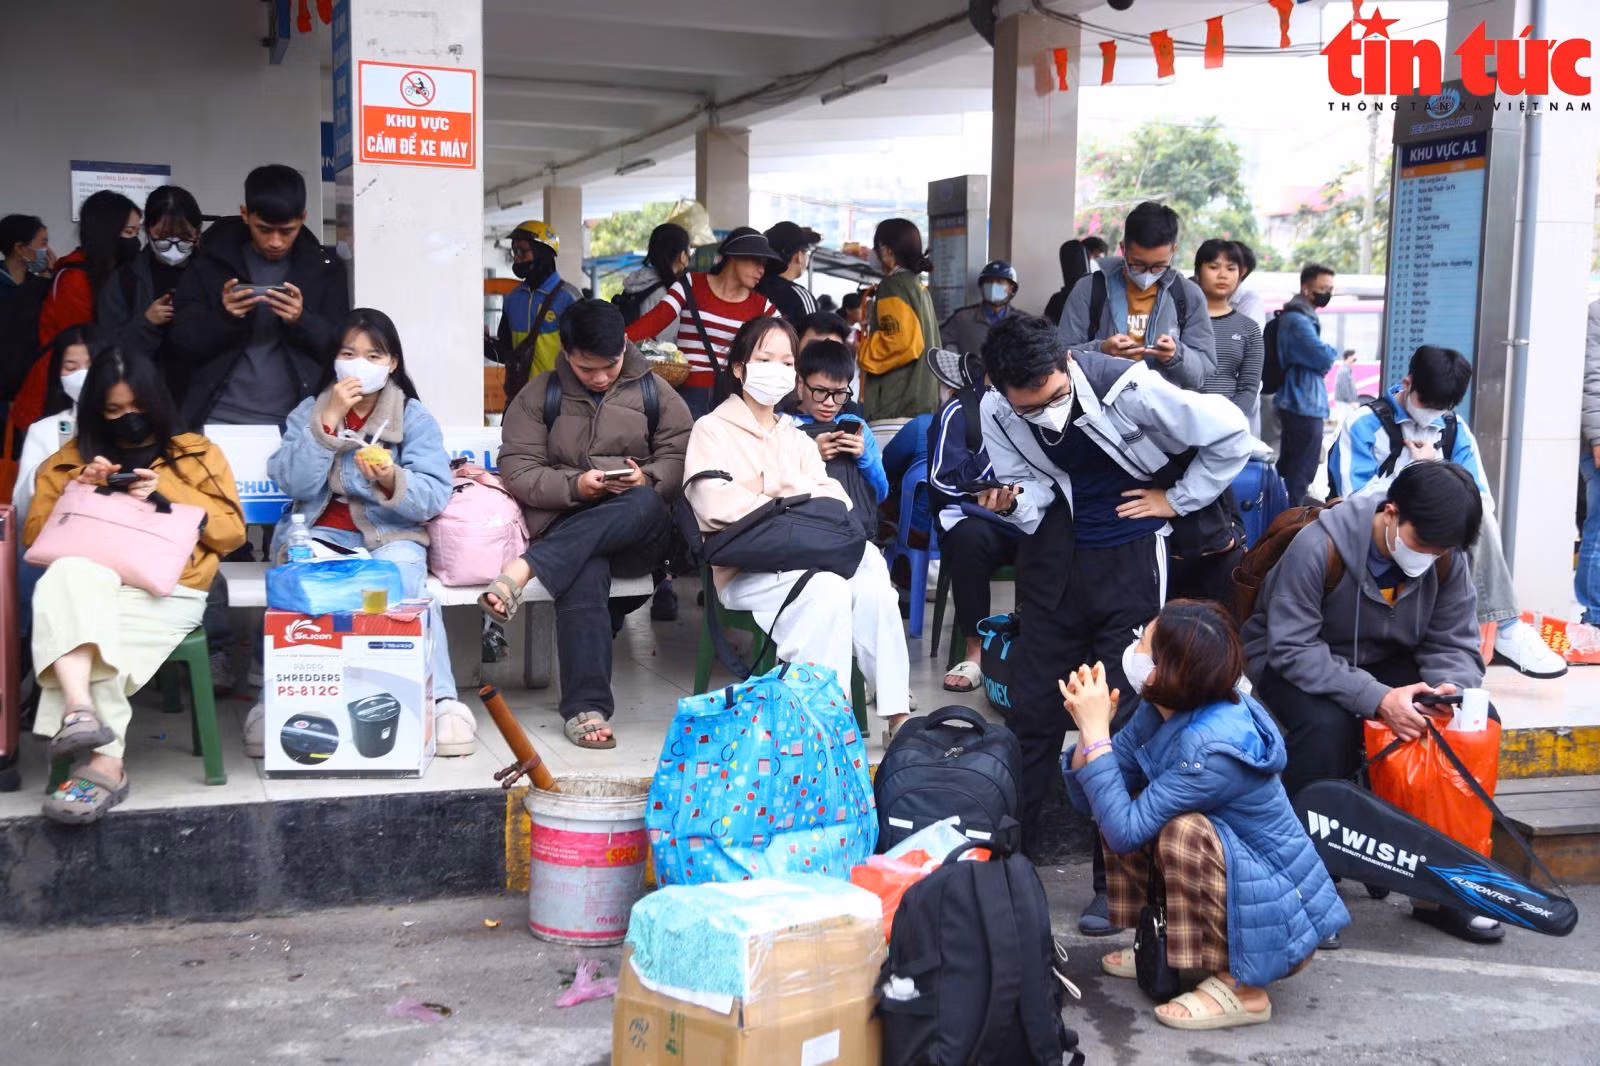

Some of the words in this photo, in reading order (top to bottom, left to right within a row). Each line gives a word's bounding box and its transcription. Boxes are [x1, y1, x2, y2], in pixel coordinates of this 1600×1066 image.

[386, 114, 416, 128] KHU
[421, 116, 450, 132] VỰC
[367, 130, 396, 154] CẤM
[399, 132, 417, 155] ĐỂ
[420, 139, 437, 157] XE
[440, 138, 469, 159] MÁY
[1410, 146, 1433, 162] KHU
[1436, 142, 1459, 160] VỰC
[1462, 140, 1477, 155] A1
[276, 674, 340, 682] SHREDDERS
[278, 686, 339, 697] PS-812C
[1450, 876, 1517, 904] FUSIONTEC
[1516, 901, 1554, 918] 799K
